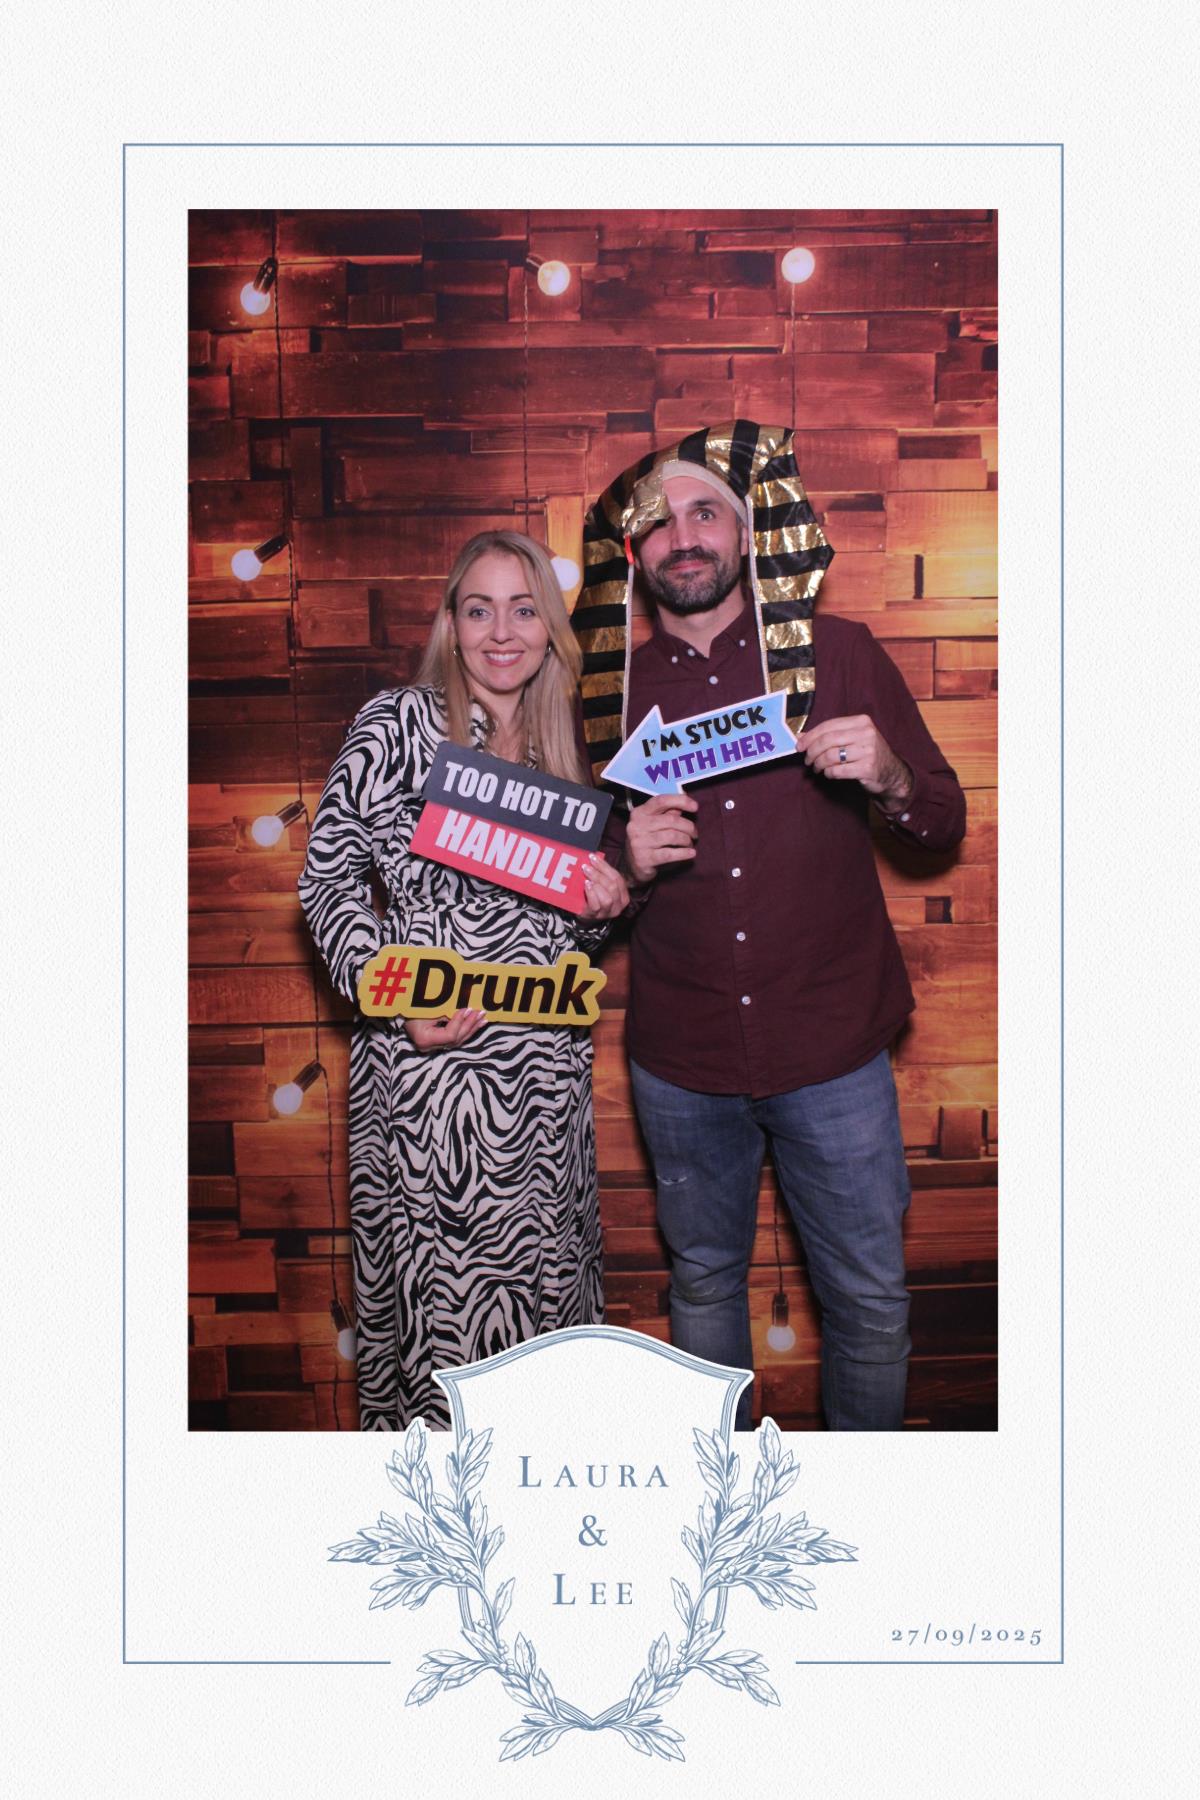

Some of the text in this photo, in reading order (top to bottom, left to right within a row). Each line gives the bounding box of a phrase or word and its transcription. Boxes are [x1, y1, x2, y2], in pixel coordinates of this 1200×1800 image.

[641, 705, 767, 758] I'M STUCK
[644, 731, 776, 784] WITH HER
[441, 760, 598, 833] TOO HOT TO
[434, 809, 578, 894] HANDLE
[368, 956, 597, 1017] #Drunk
